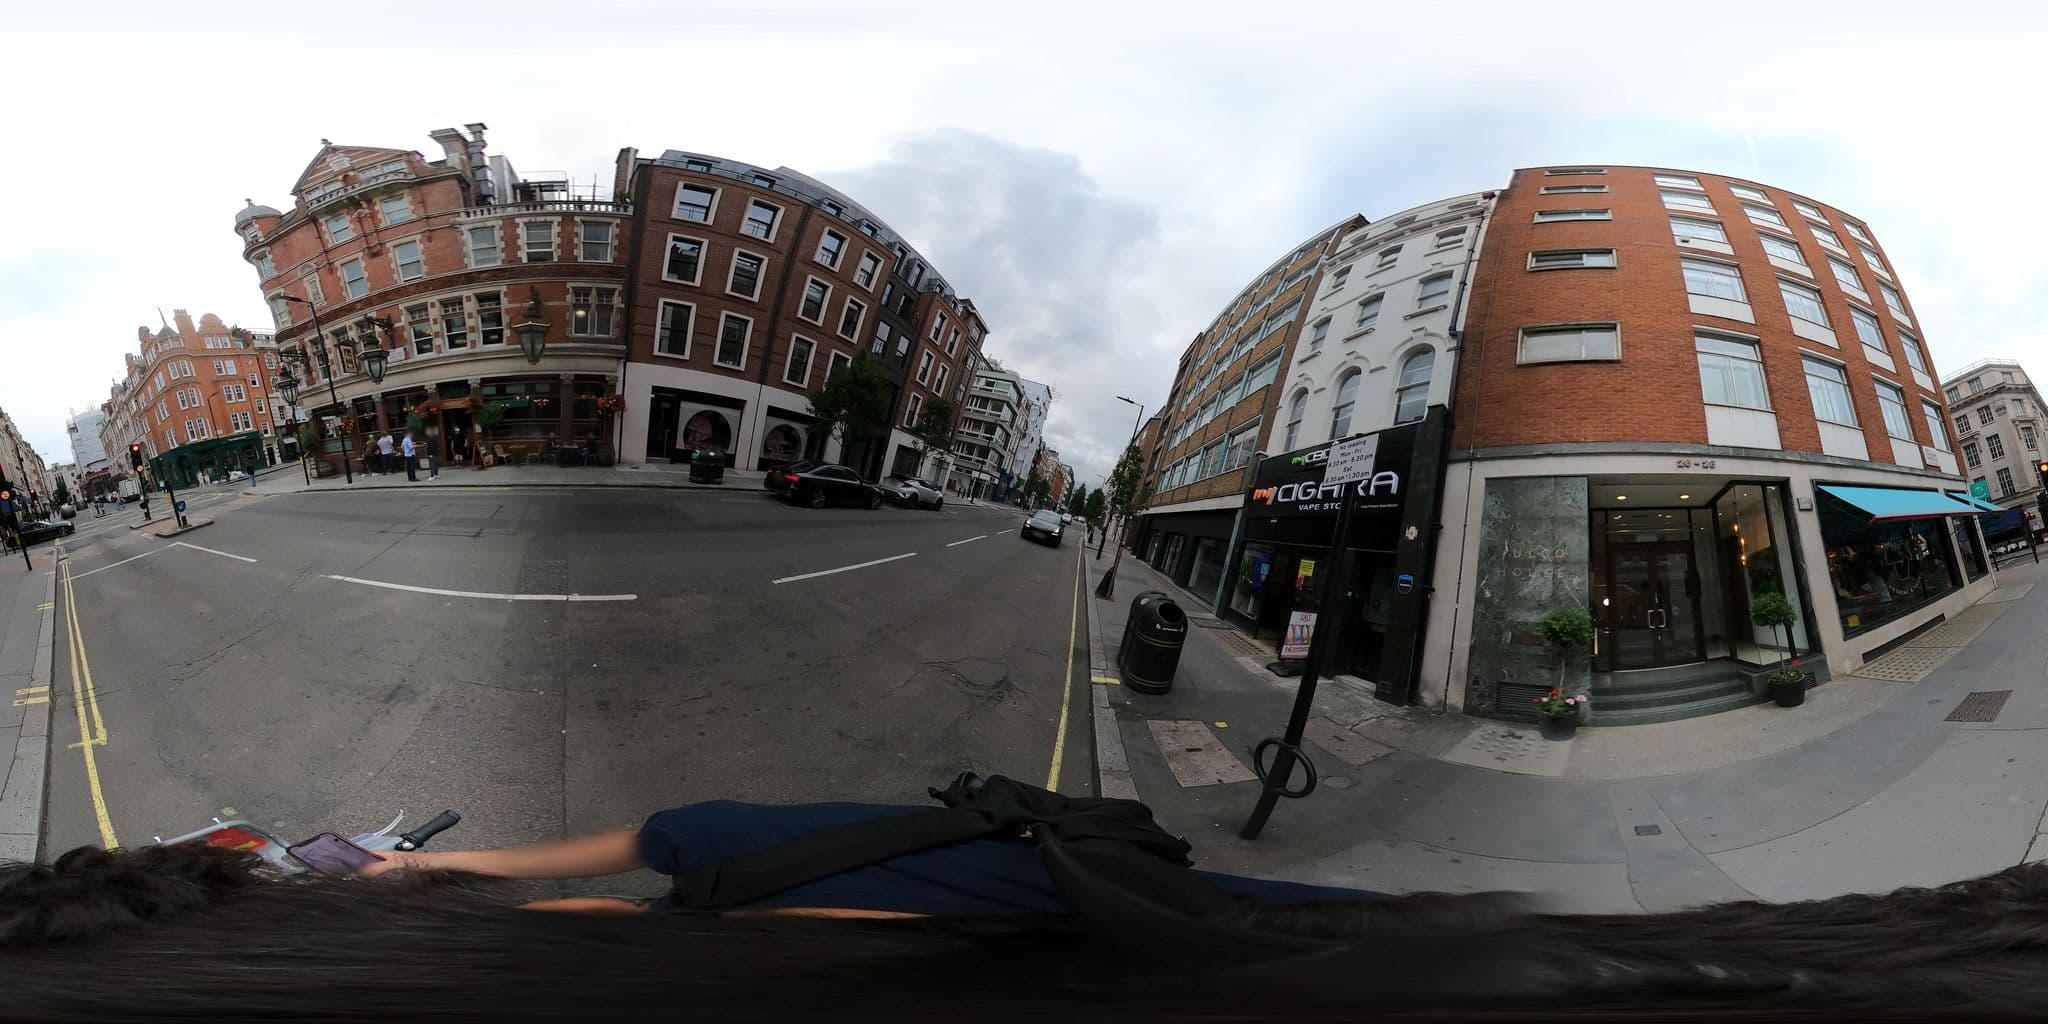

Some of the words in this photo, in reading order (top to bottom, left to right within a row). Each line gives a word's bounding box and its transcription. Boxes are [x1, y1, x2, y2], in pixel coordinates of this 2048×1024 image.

[1347, 439, 1367, 448] loading
[1299, 503, 1320, 511] VAPE
[1323, 502, 1342, 510] STO
[1496, 566, 1565, 578] HOUSE
